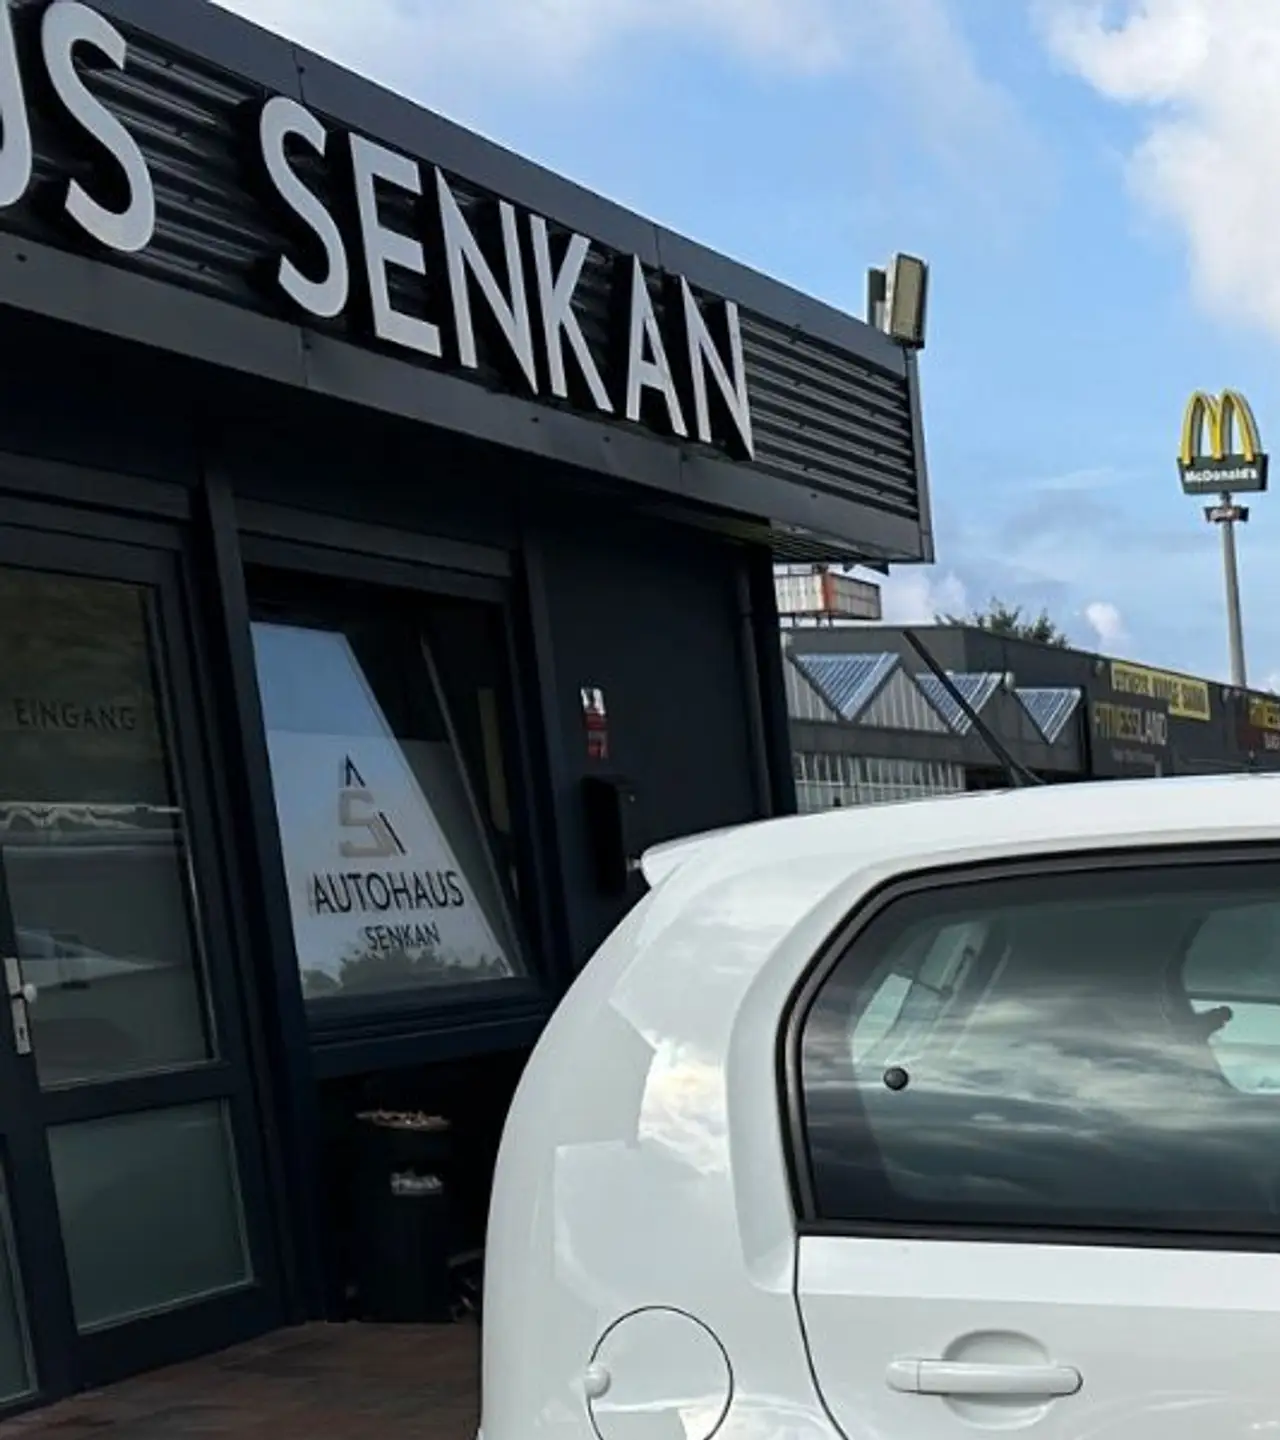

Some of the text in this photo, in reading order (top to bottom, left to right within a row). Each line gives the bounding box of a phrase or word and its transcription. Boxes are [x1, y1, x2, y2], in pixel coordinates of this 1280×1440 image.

[259, 96, 755, 461] SENKAN
[12, 698, 137, 732] EINGANG
[312, 869, 465, 915] AUTOHAUS
[363, 921, 441, 950] SENKAN
